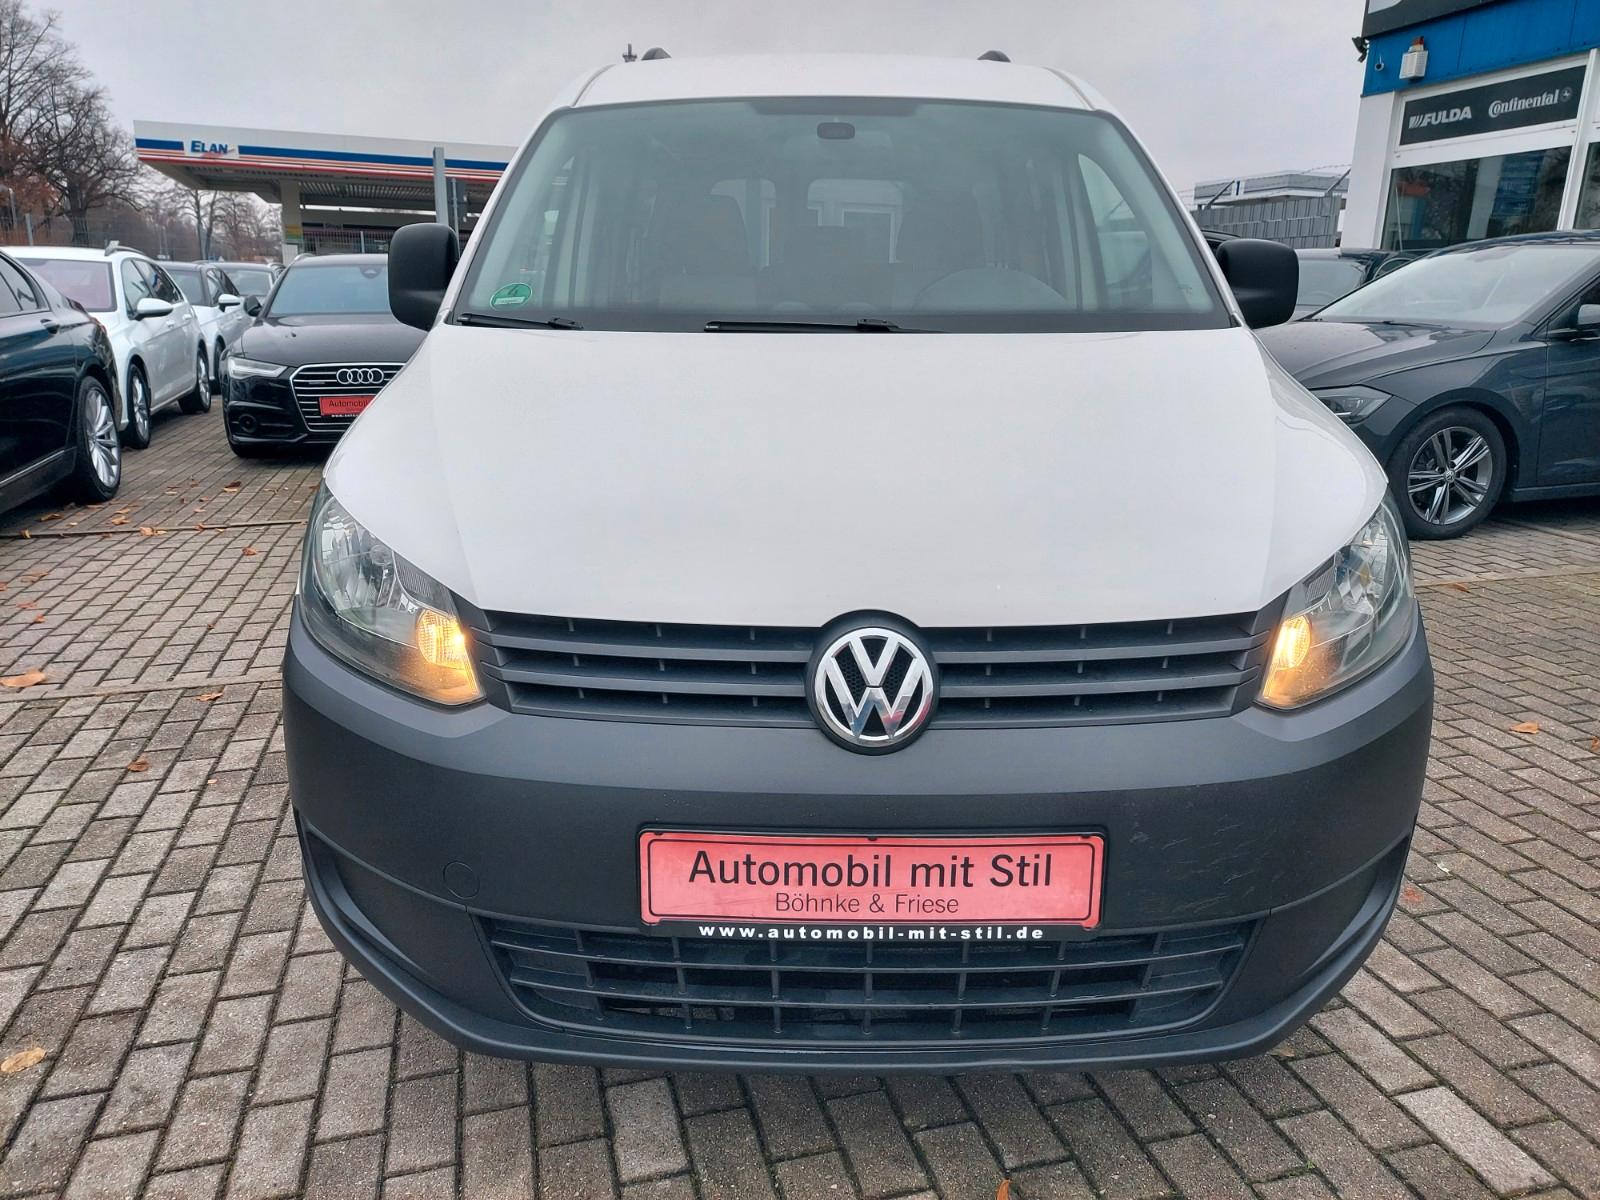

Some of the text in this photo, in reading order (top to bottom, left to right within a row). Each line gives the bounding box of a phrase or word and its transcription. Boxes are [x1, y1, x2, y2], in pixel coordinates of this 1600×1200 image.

[1488, 88, 1560, 118] Continental
[1420, 106, 1473, 127] FULDA
[190, 140, 229, 154] ELAN
[688, 850, 1053, 888] Automobil mit Stil
[775, 892, 961, 913] Böhnke & Friese
[698, 925, 1044, 940] www.automobil-mit-stil.de
